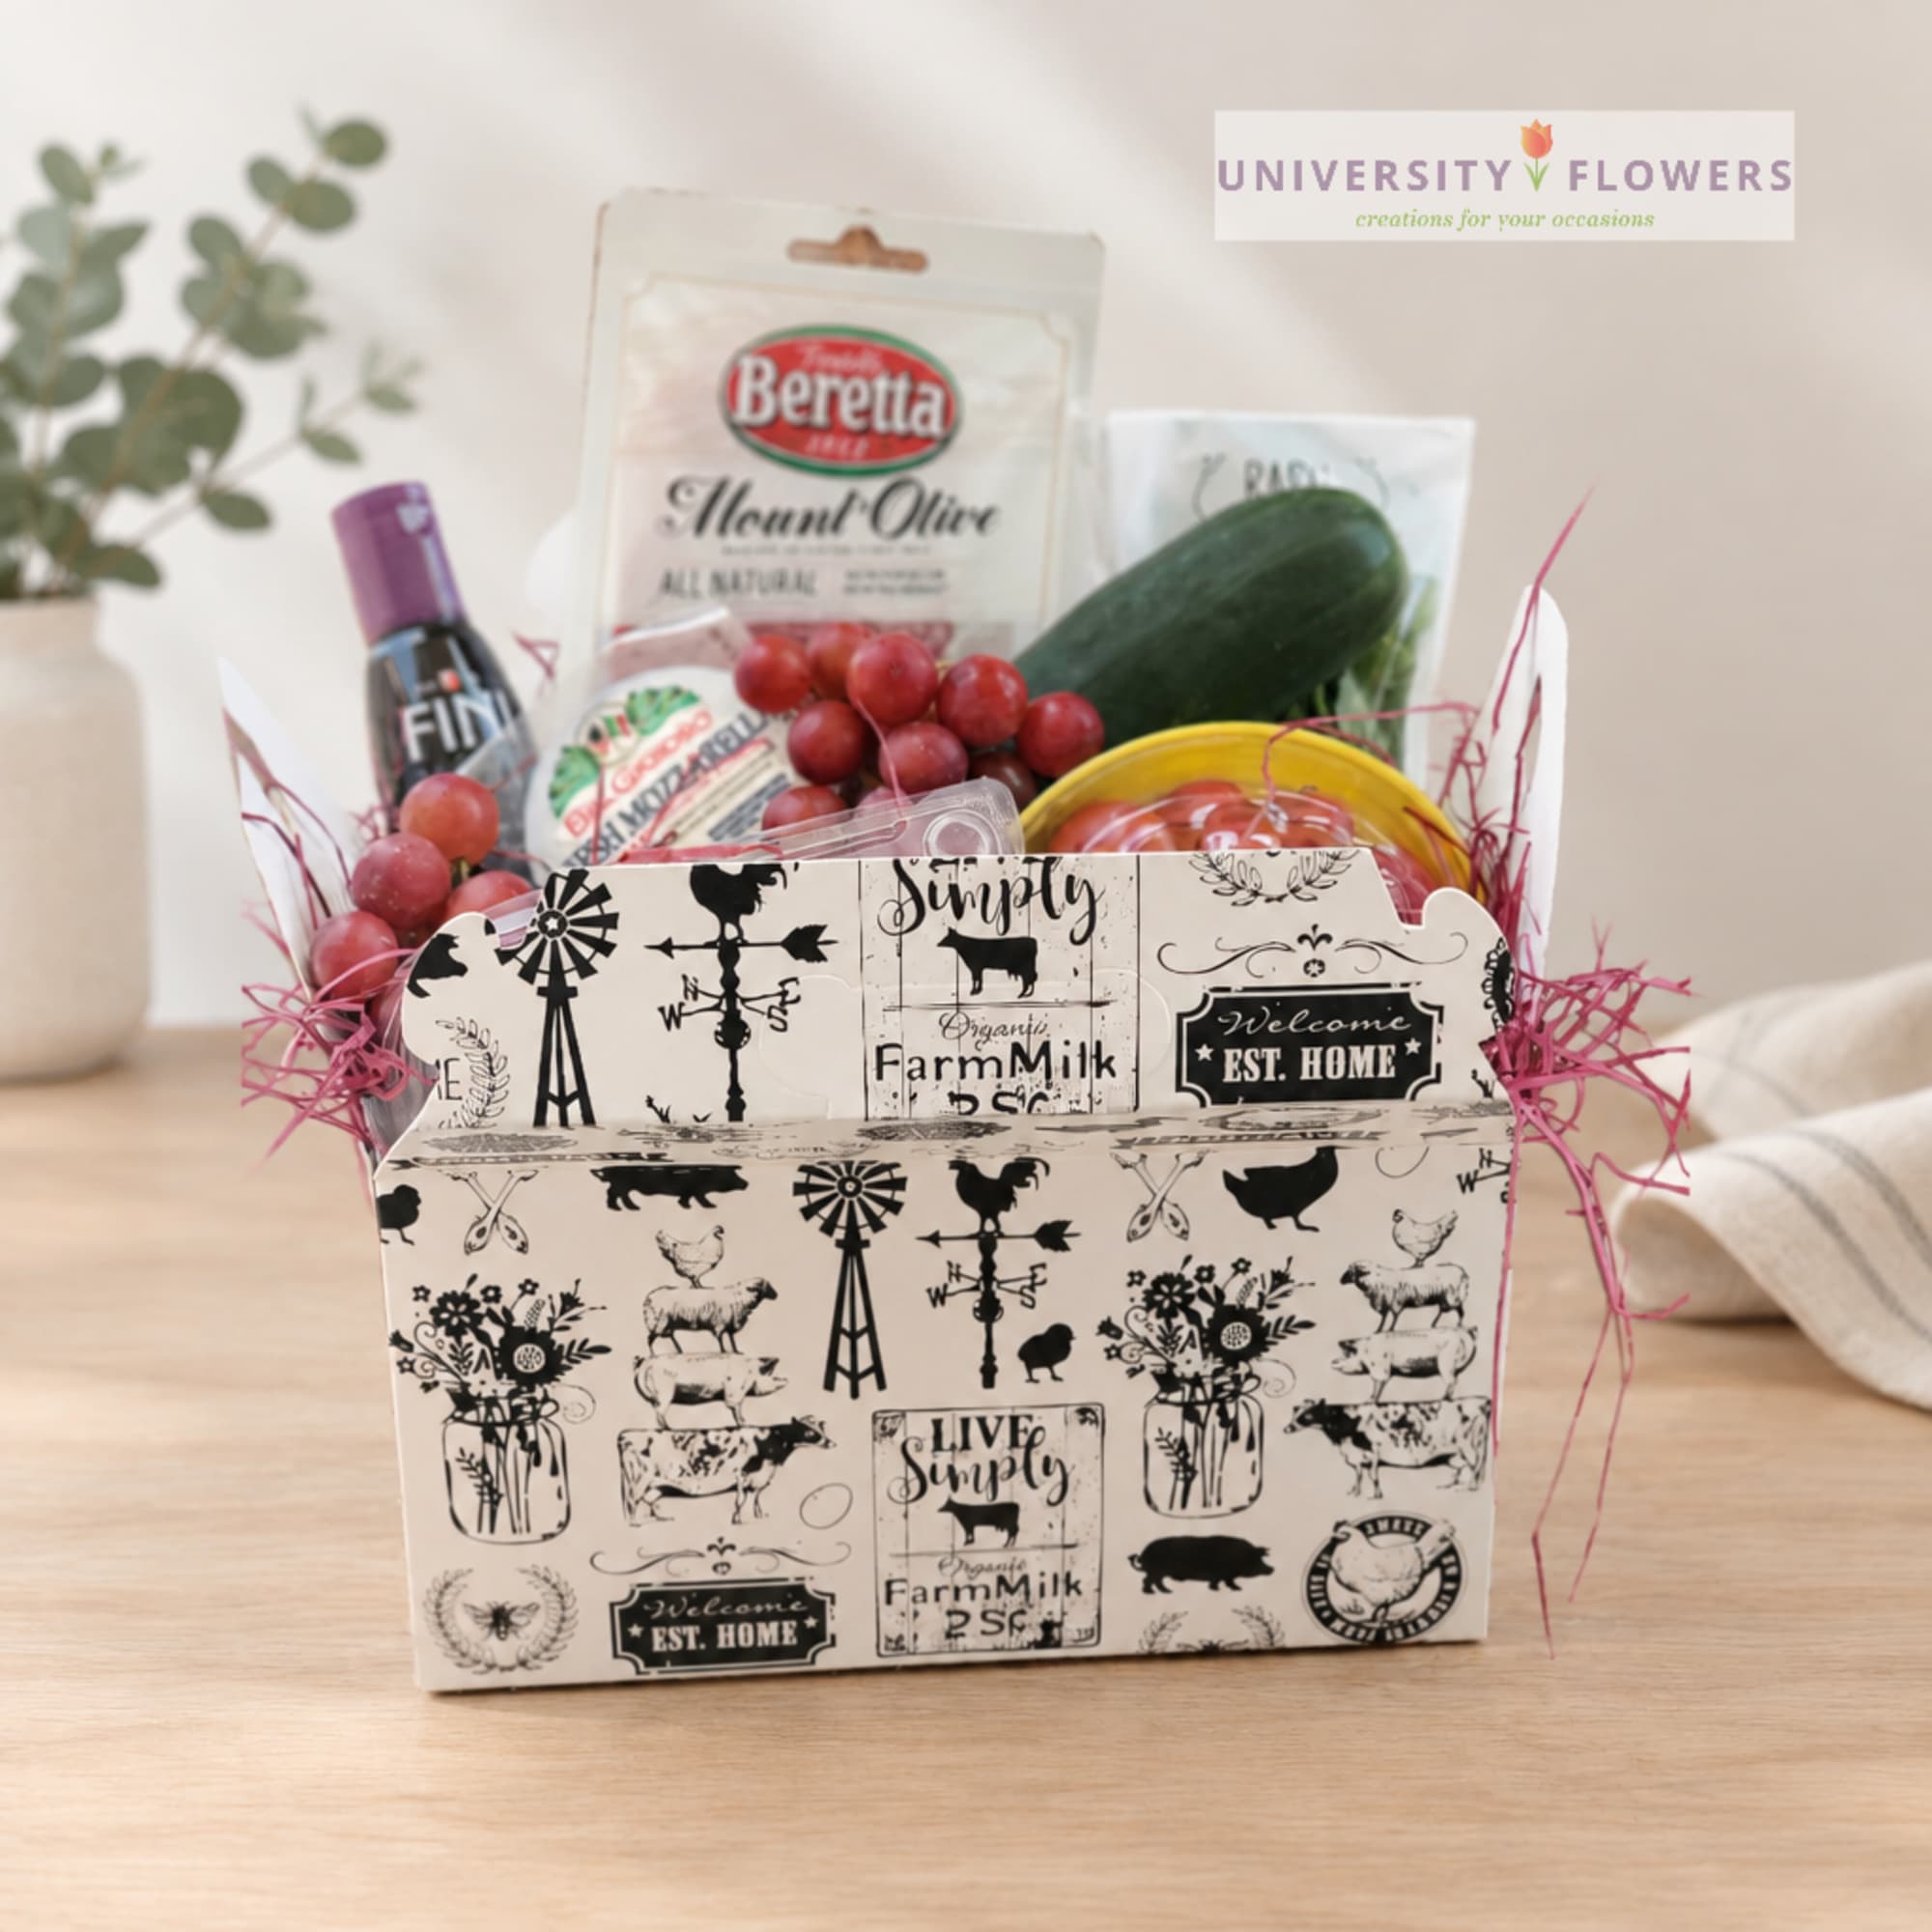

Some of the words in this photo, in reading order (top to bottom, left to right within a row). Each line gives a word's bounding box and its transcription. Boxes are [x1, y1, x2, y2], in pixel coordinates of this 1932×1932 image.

[730, 354, 947, 440] Beretta
[660, 475, 858, 540] Mount
[869, 475, 998, 541] Olive
[660, 568, 703, 599] ALL
[709, 567, 820, 597] NATURAL
[617, 712, 770, 836] MOZZARELL
[877, 856, 1105, 946] Simply
[1217, 1006, 1413, 1035] Welcome
[1222, 1047, 1287, 1083] EST.
[1299, 1044, 1397, 1081] HOME
[930, 1414, 1035, 1454] LIVE
[887, 1426, 1075, 1507] Simply
[643, 1596, 809, 1619] Welcome
[651, 1625, 706, 1653] EST.
[717, 1620, 798, 1649] HOME
